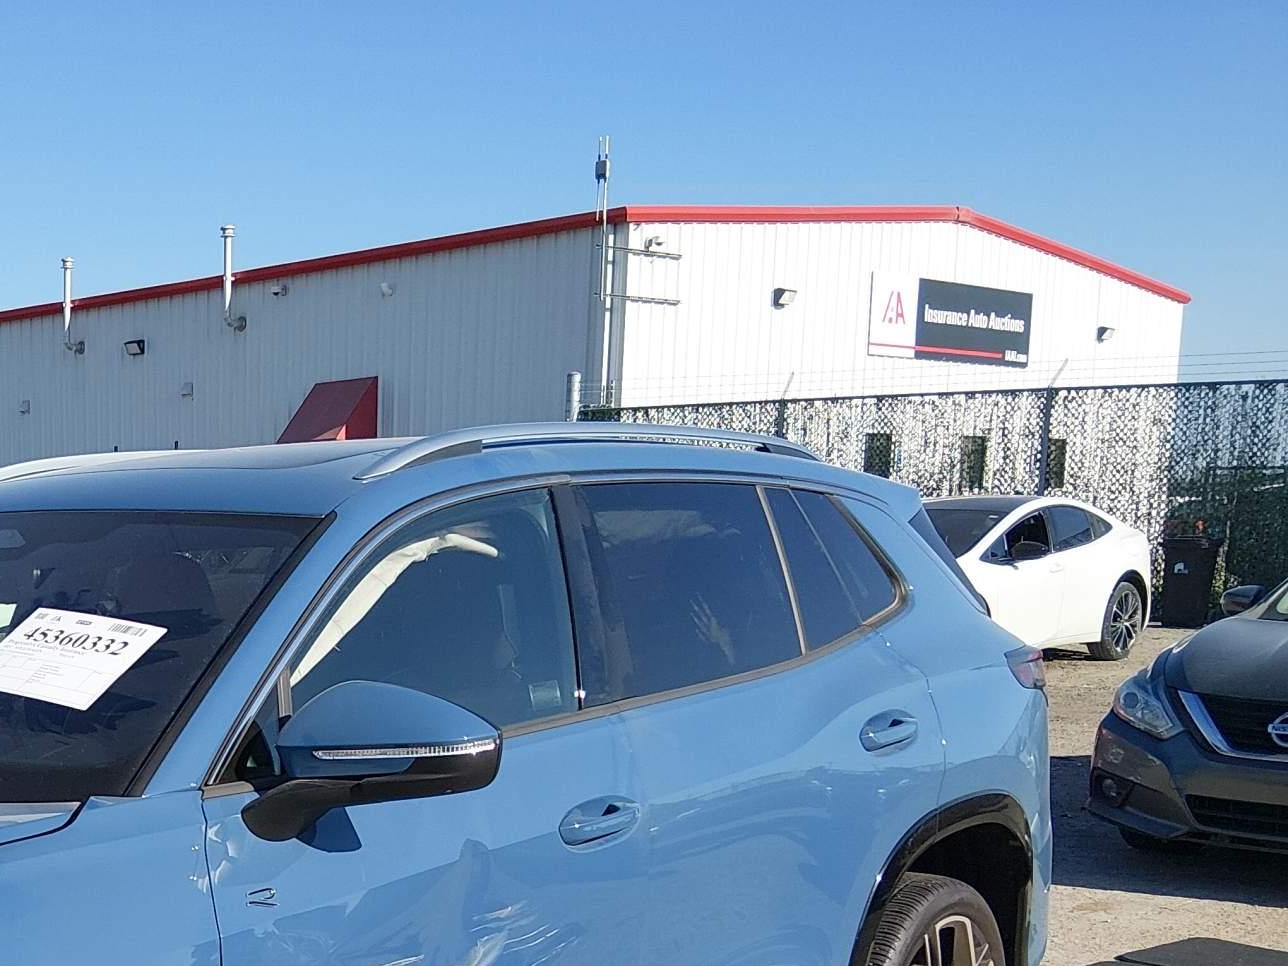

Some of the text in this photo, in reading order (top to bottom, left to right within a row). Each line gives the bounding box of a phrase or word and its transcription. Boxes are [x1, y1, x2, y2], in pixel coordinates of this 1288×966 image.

[924, 304, 1025, 333] Insurance Auto Auctions
[23, 626, 129, 655] 45360332
